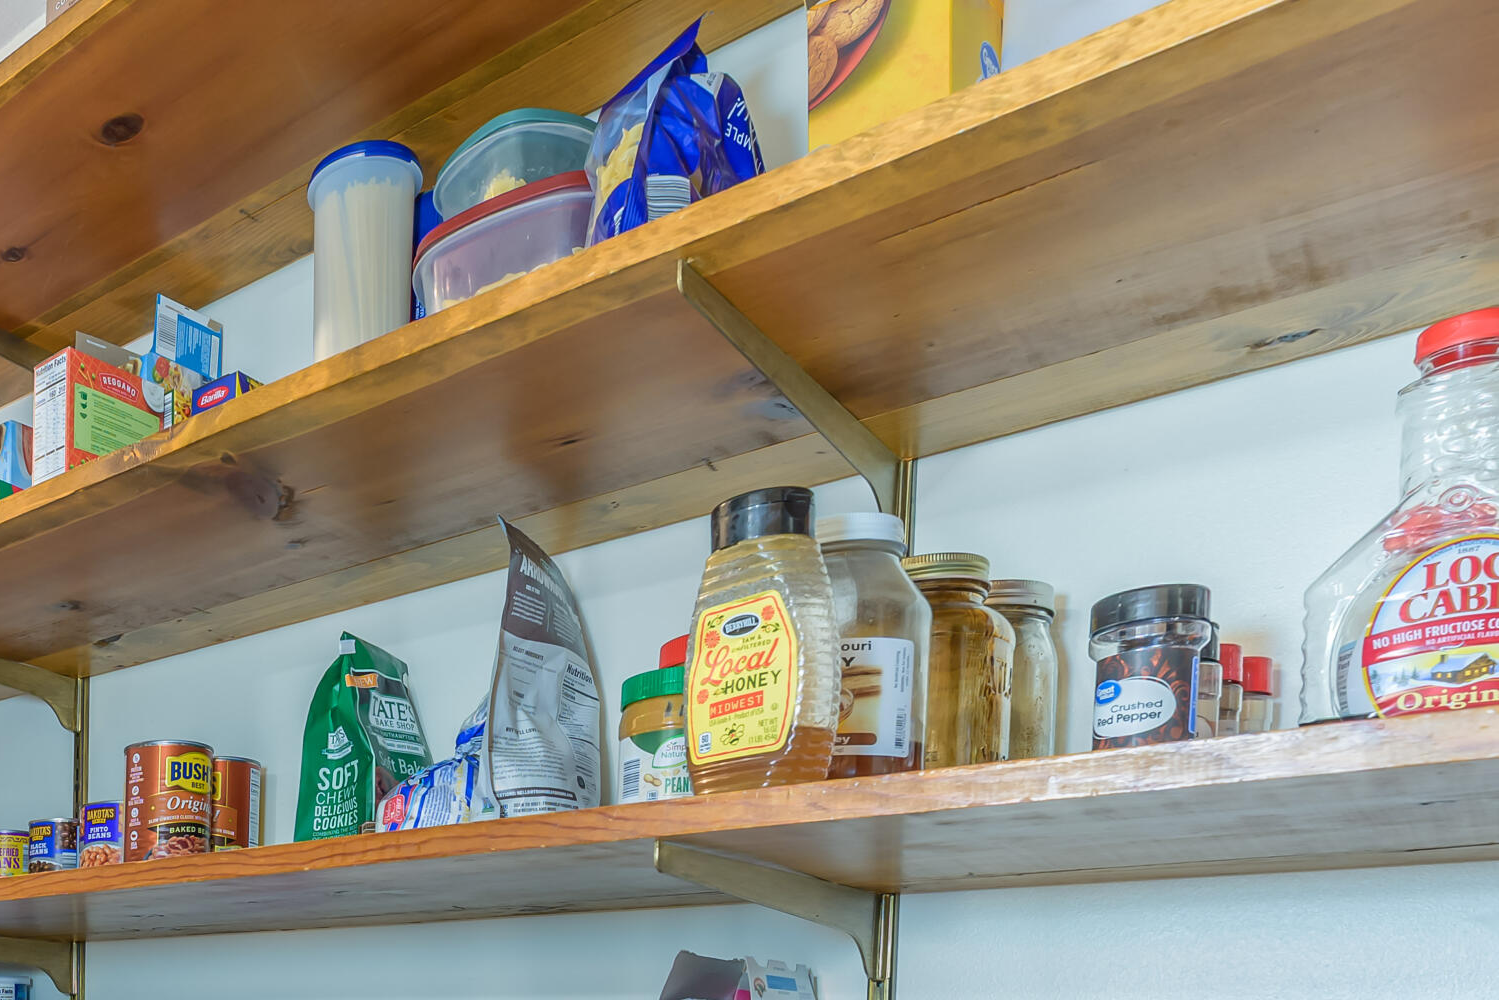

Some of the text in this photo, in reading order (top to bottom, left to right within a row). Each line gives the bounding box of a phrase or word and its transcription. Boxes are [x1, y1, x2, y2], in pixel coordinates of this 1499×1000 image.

[102, 376, 136, 397] REGGANO
[200, 390, 226, 406] Barilla
[1372, 618, 1486, 649] NO HIGH FRUCTOSE
[701, 638, 779, 686] Local
[567, 664, 593, 684] Nutrition
[724, 669, 782, 695] HONEY
[710, 694, 763, 715] MIDWEST
[1111, 700, 1163, 713] Crushed
[396, 721, 415, 731] SHOP
[1097, 711, 1162, 727] Red Pepper
[317, 759, 359, 790] SOFT
[191, 782, 205, 790] BEST
[316, 783, 358, 805] CHEWY
[314, 797, 358, 817] DELICIOUS
[169, 826, 196, 834] BAKED
[313, 810, 359, 831] COOKIES
[87, 832, 112, 840] BEANS
